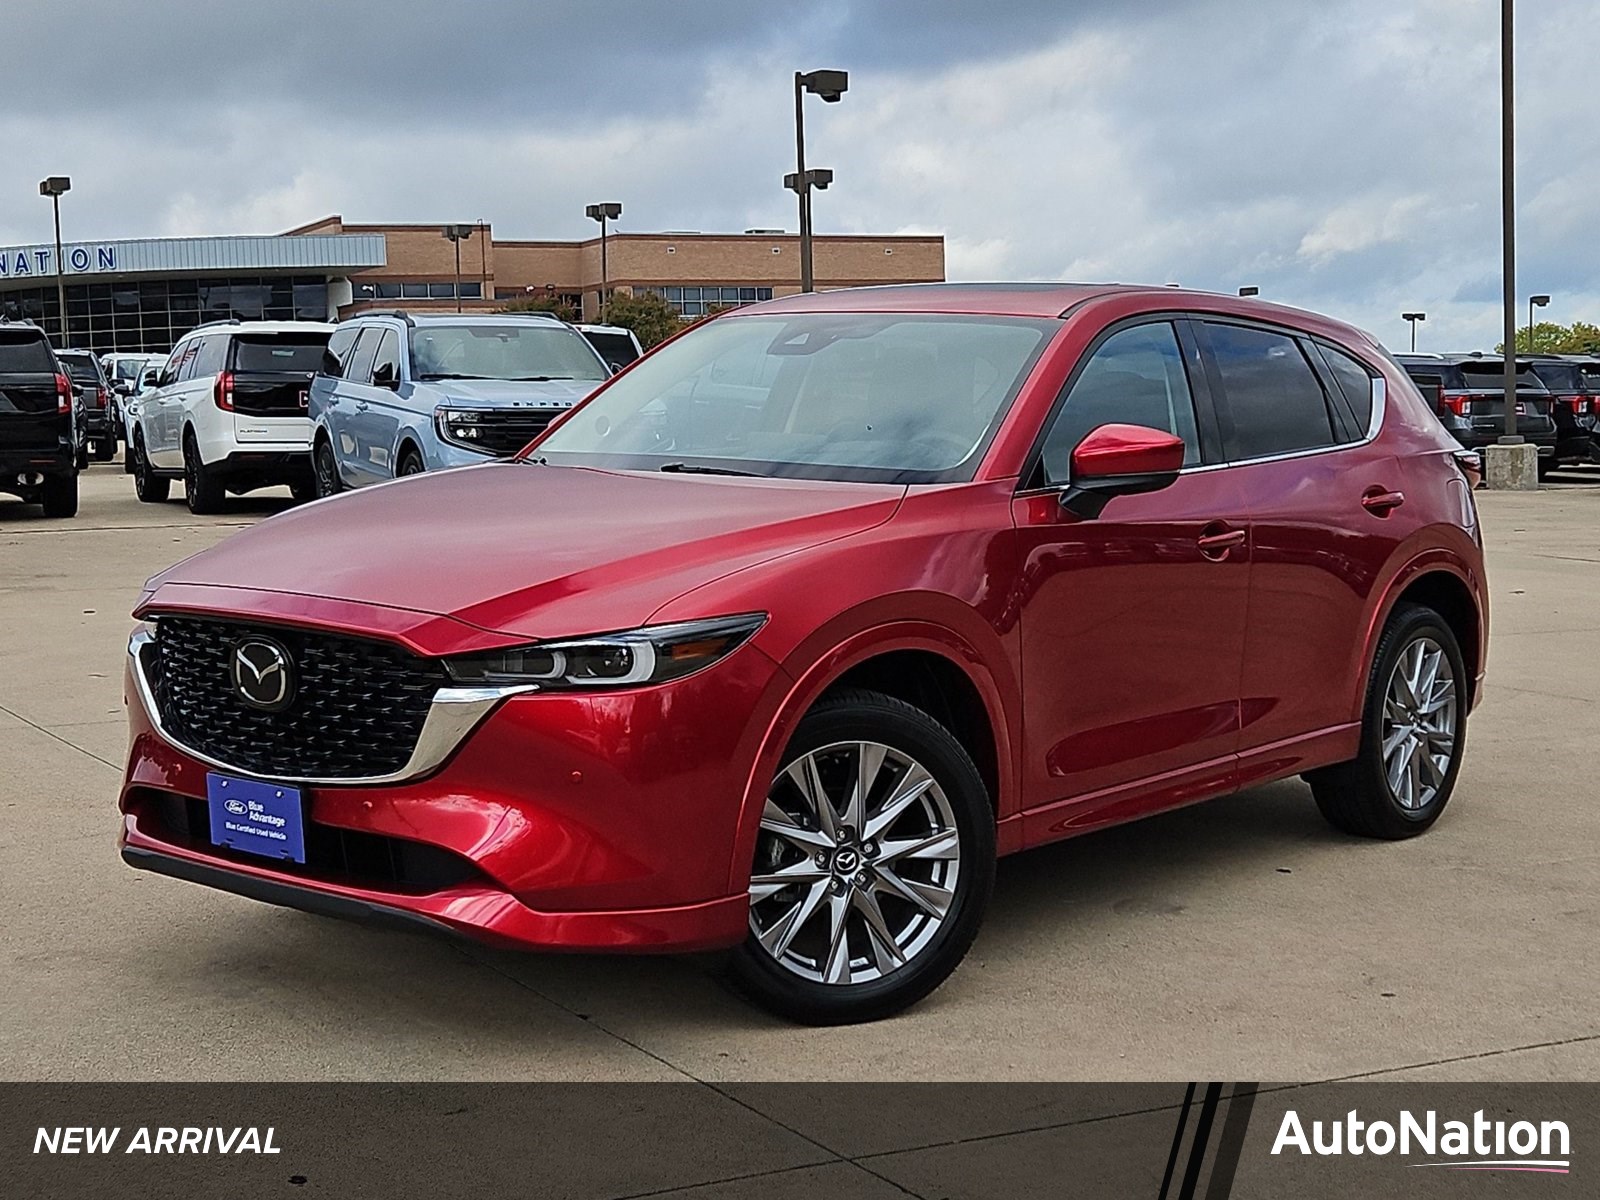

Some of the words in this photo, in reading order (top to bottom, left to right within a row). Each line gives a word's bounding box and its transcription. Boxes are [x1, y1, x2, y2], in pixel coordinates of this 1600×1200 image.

[0, 247, 115, 274] ATON
[248, 801, 263, 812] Blue
[249, 811, 285, 827] Advantage
